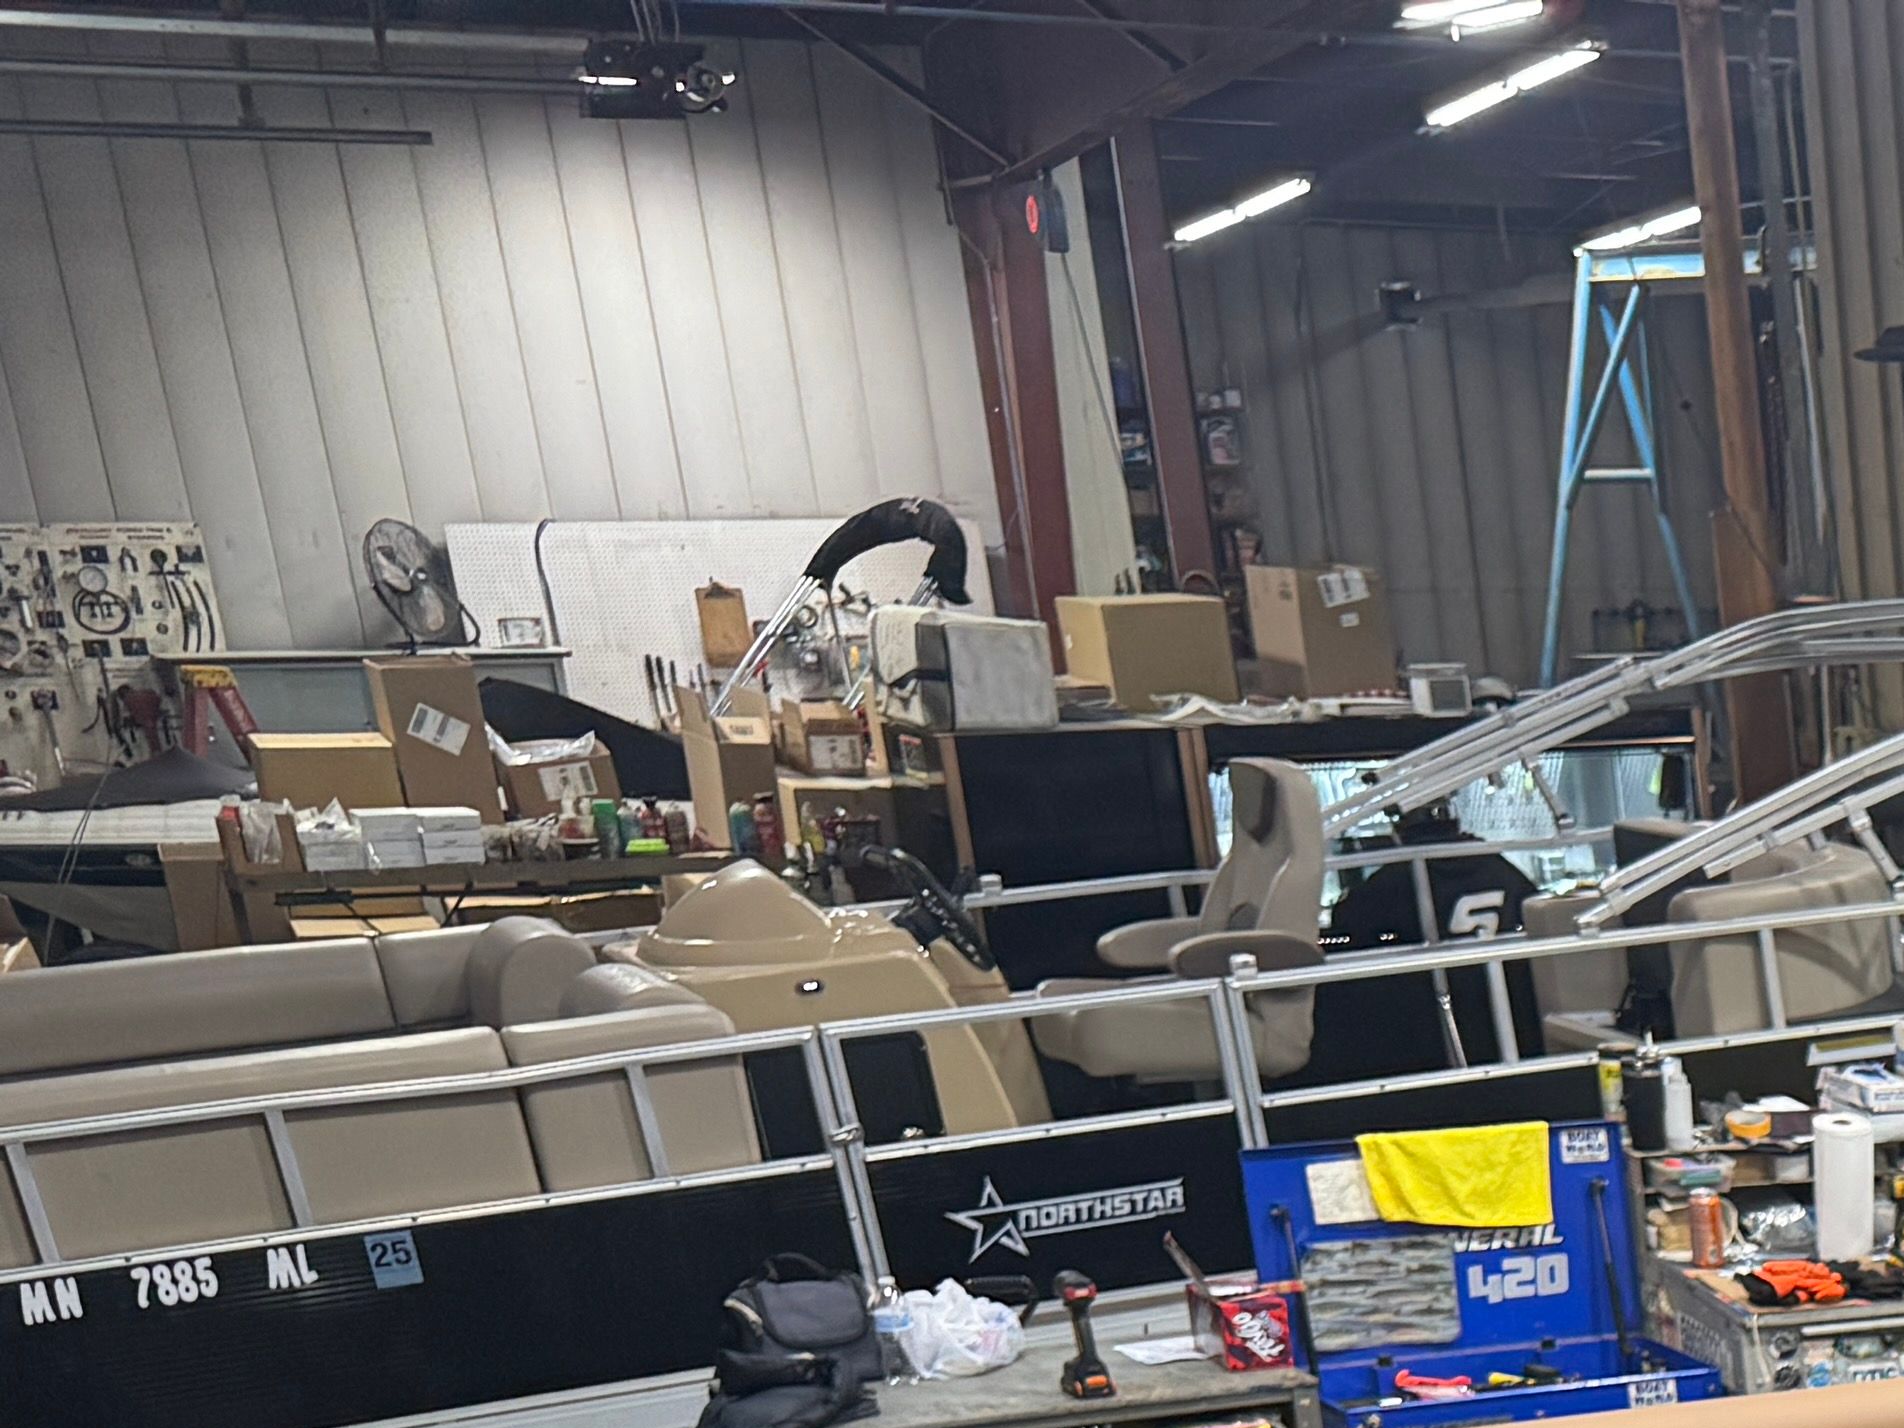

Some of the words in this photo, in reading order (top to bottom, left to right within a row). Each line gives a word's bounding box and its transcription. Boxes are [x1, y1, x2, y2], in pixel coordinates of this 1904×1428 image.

[1018, 1185, 1185, 1230] NORTHSTAR
[20, 1276, 84, 1326] MN
[130, 1256, 219, 1309] 7885
[266, 1243, 320, 1290] ML
[370, 1239, 413, 1268] 25
[1467, 1251, 1570, 1305] 420
